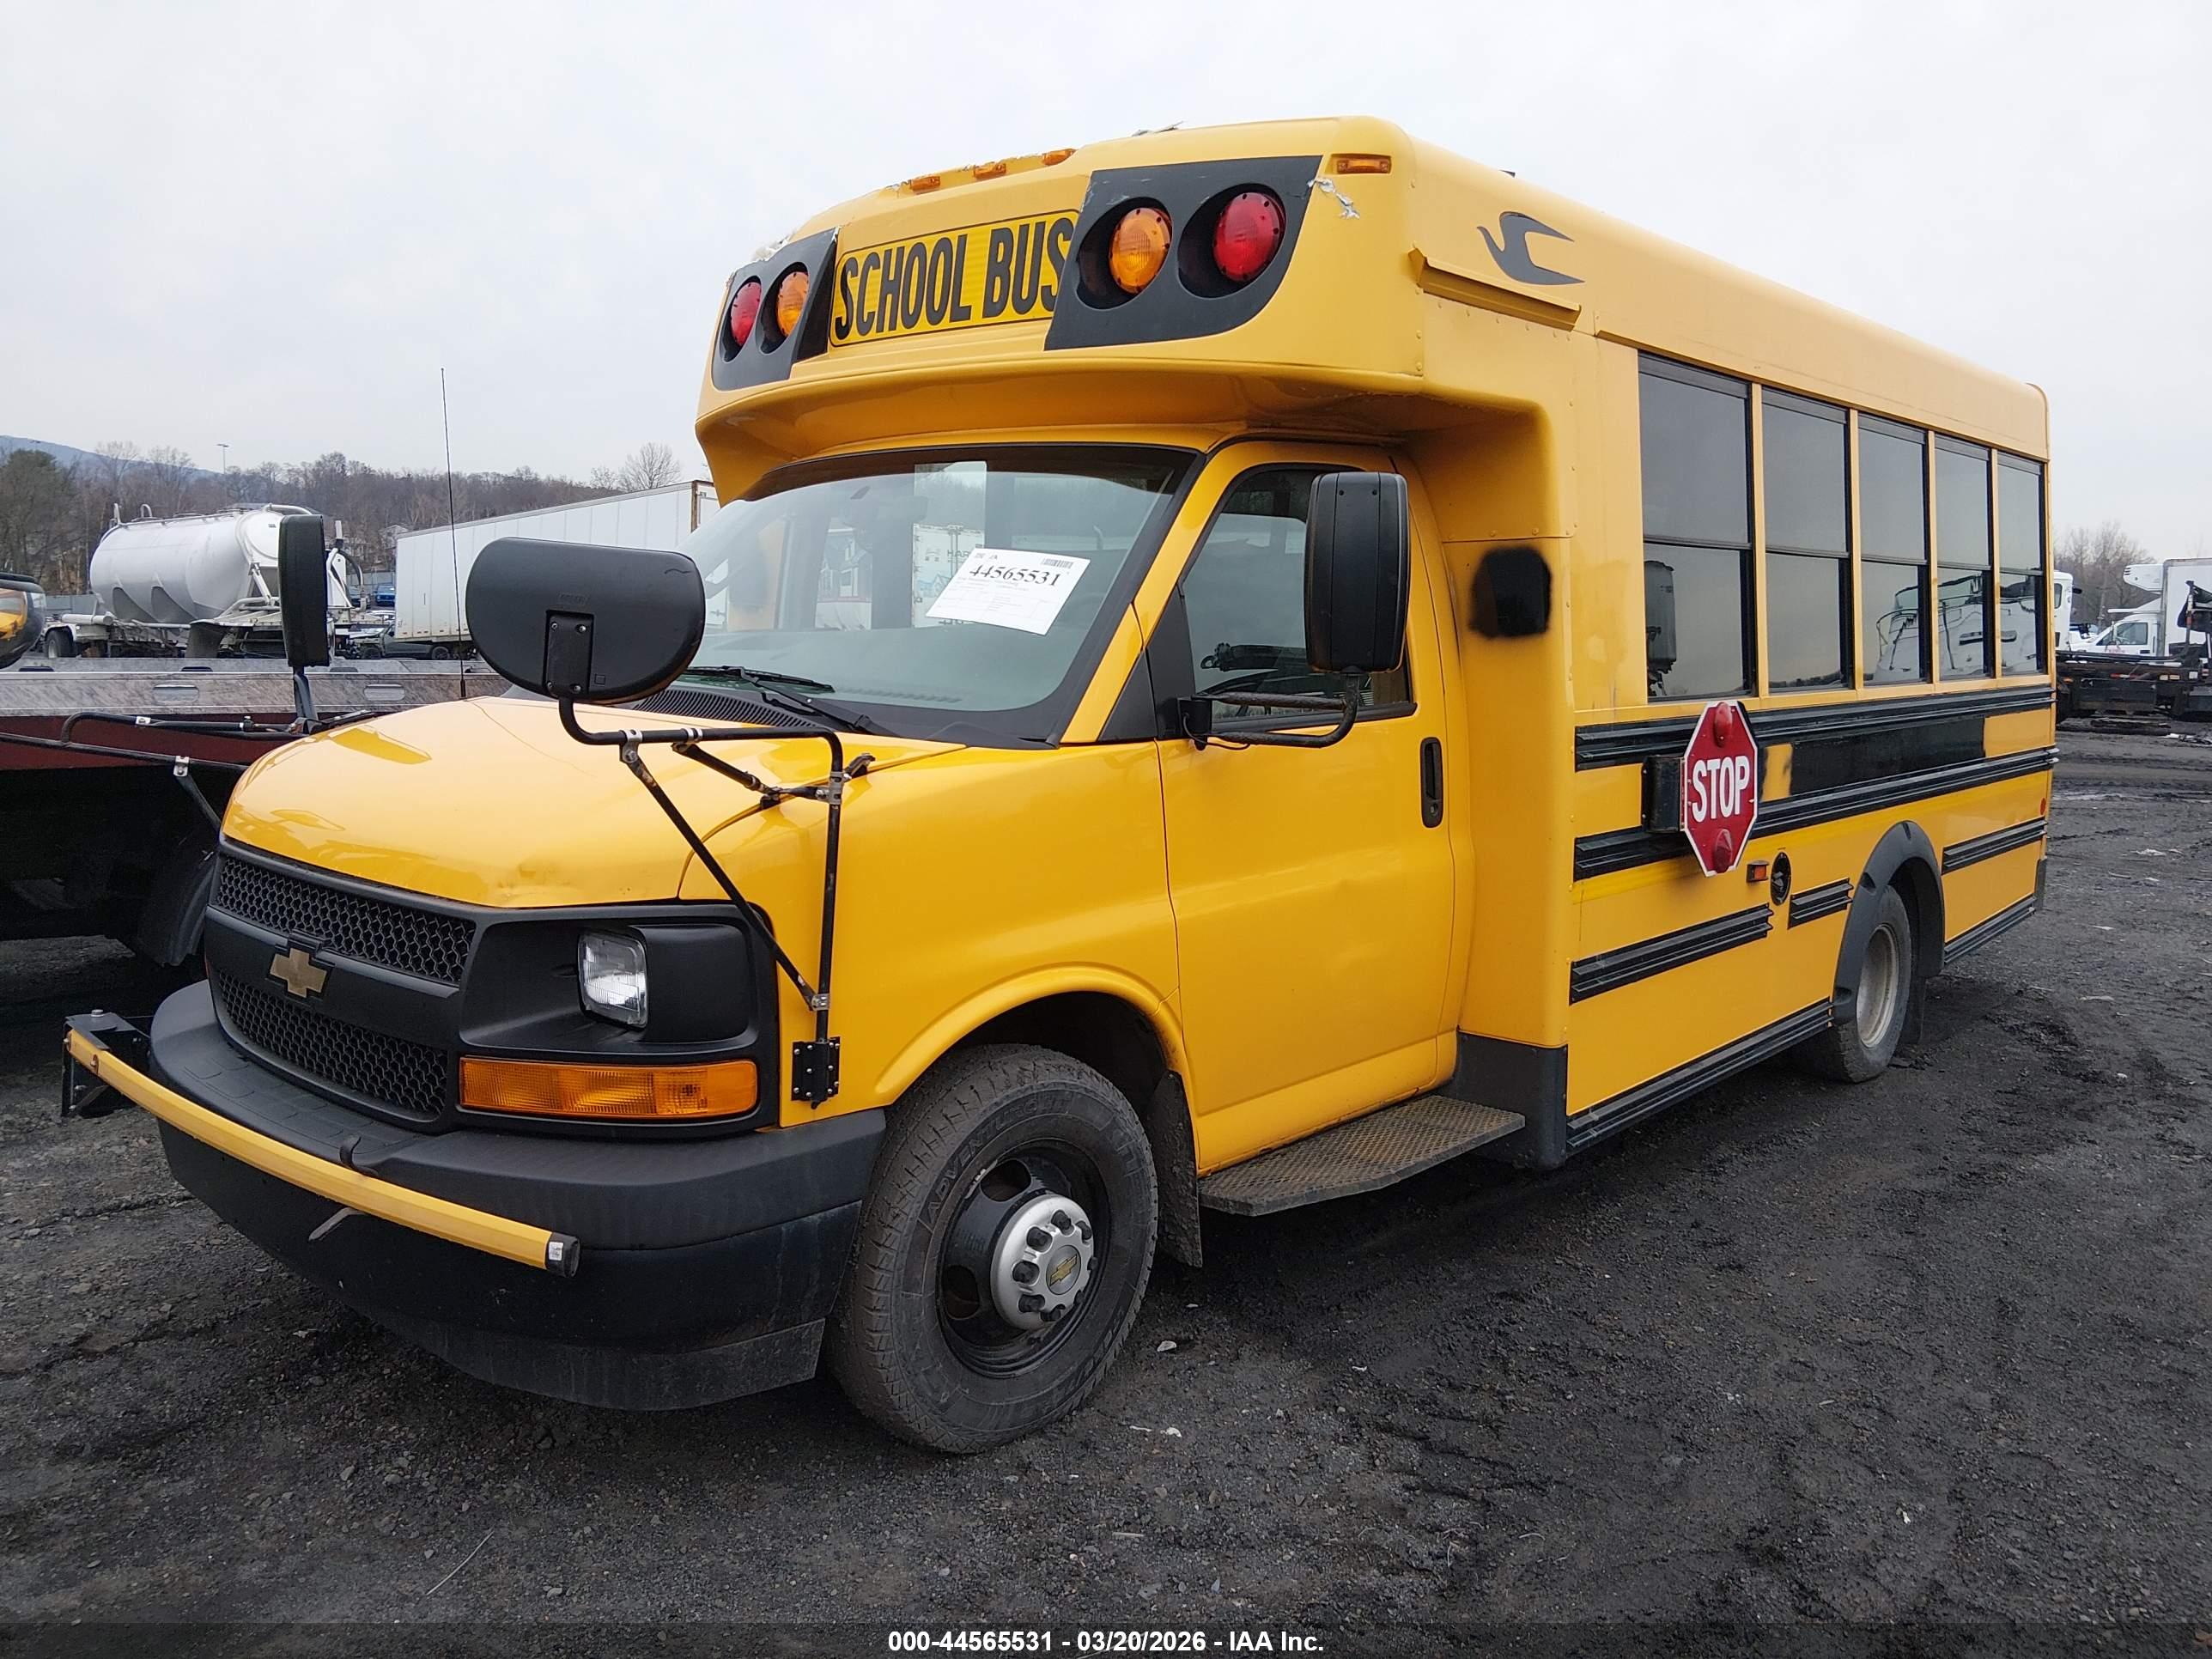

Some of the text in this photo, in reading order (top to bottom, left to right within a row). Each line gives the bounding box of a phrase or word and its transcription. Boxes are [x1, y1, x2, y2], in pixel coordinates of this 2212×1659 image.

[835, 216, 1073, 341] SCHOOL BUS
[969, 564, 1060, 586] 44565531
[1692, 755, 1750, 823] STOP
